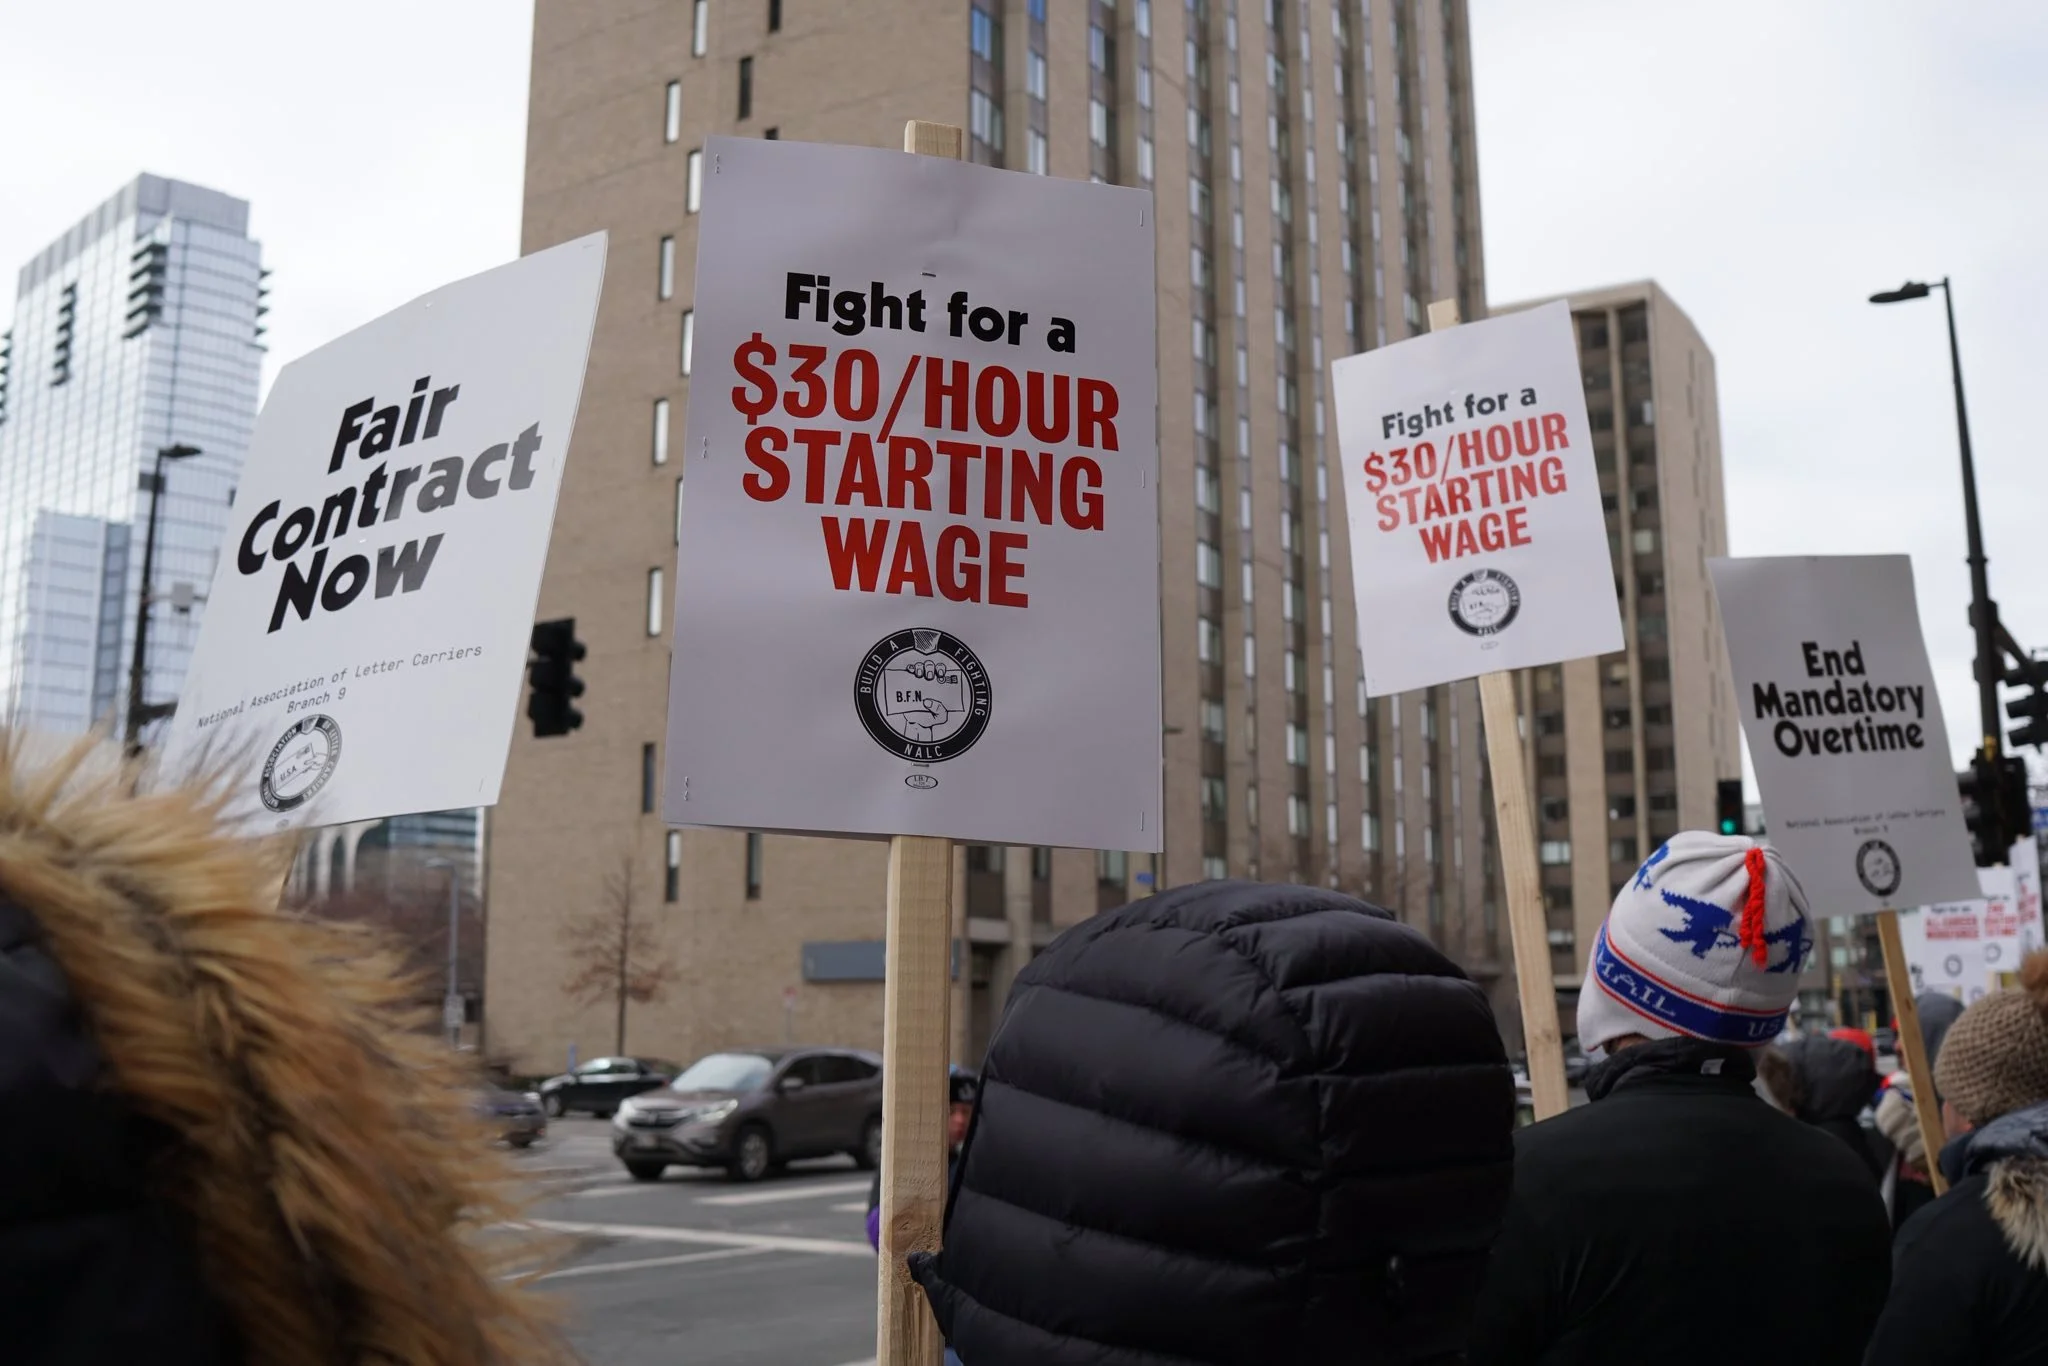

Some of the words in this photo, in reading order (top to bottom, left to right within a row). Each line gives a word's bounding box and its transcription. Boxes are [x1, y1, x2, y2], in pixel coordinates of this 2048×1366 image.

[784, 271, 928, 336] Fight
[947, 291, 1029, 346] for
[1046, 316, 1076, 354] a
[327, 375, 461, 475] Fair
[731, 332, 1120, 452] $30/HOUR
[1382, 401, 1455, 440] Fight
[1464, 393, 1509, 419] for
[1520, 387, 1537, 406] a
[741, 425, 1105, 532] STARTING
[1363, 412, 1570, 496] $30/HOUR
[236, 420, 544, 576] Contract
[1376, 456, 1568, 533] STARTING
[820, 515, 1029, 609] WAGE
[1418, 506, 1533, 565] WAGE
[266, 532, 446, 634] Now
[197, 700, 245, 729] National
[249, 675, 325, 708] Association
[330, 668, 348, 684] of
[354, 658, 405, 679] Letter
[412, 645, 484, 667] Carriers
[859, 653, 883, 694] BUILD
[889, 639, 899, 651] A
[954, 647, 988, 717] FIGHTING
[1801, 640, 1866, 679] End
[286, 691, 331, 715] Branch
[337, 686, 347, 701] 9
[1752, 680, 1925, 719] Mandatory
[903, 743, 943, 759] NALC
[1773, 716, 1925, 758] Overtime
[1597, 945, 1676, 1016] MAIL
